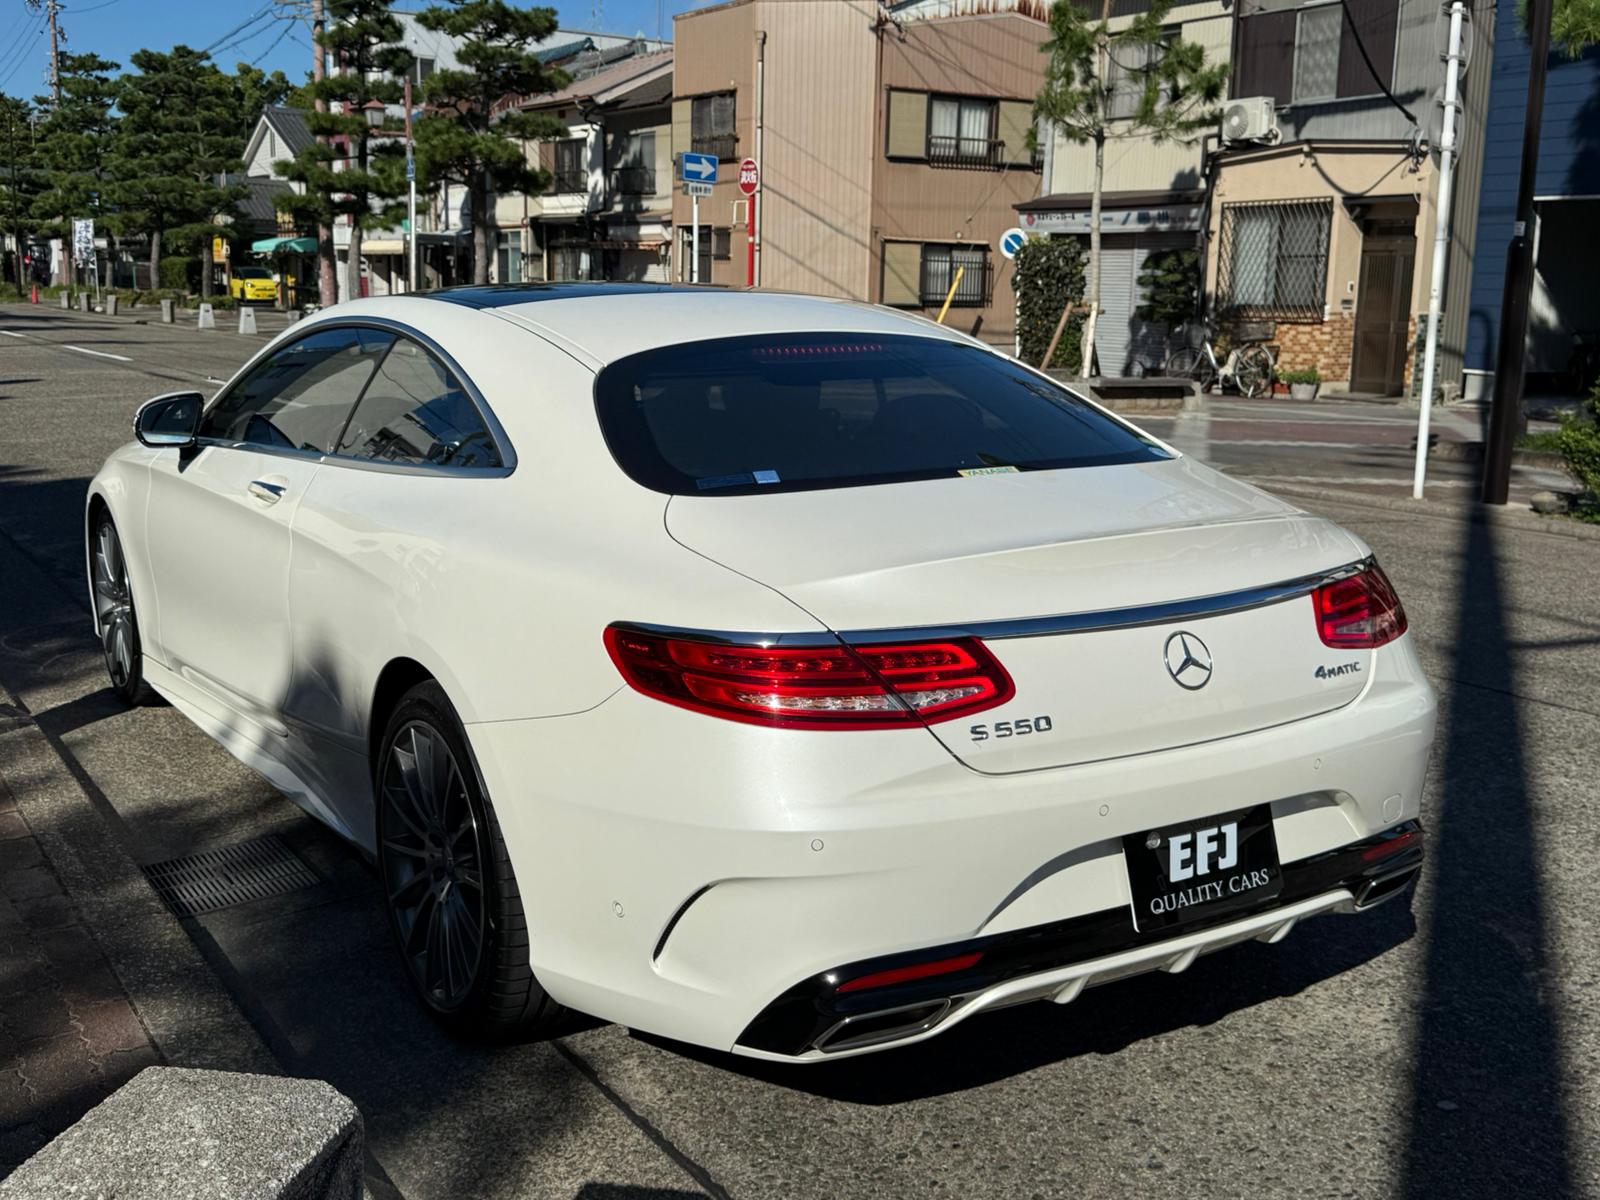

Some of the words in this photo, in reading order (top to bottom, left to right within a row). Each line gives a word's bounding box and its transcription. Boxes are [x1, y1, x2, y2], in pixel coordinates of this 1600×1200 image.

[1314, 661, 1361, 679] 4MATIC
[970, 724, 989, 741] S
[994, 715, 1052, 738] 550
[1168, 822, 1238, 883] EFJ
[1150, 880, 1223, 915] QUALITY
[1228, 868, 1270, 893] CARS
